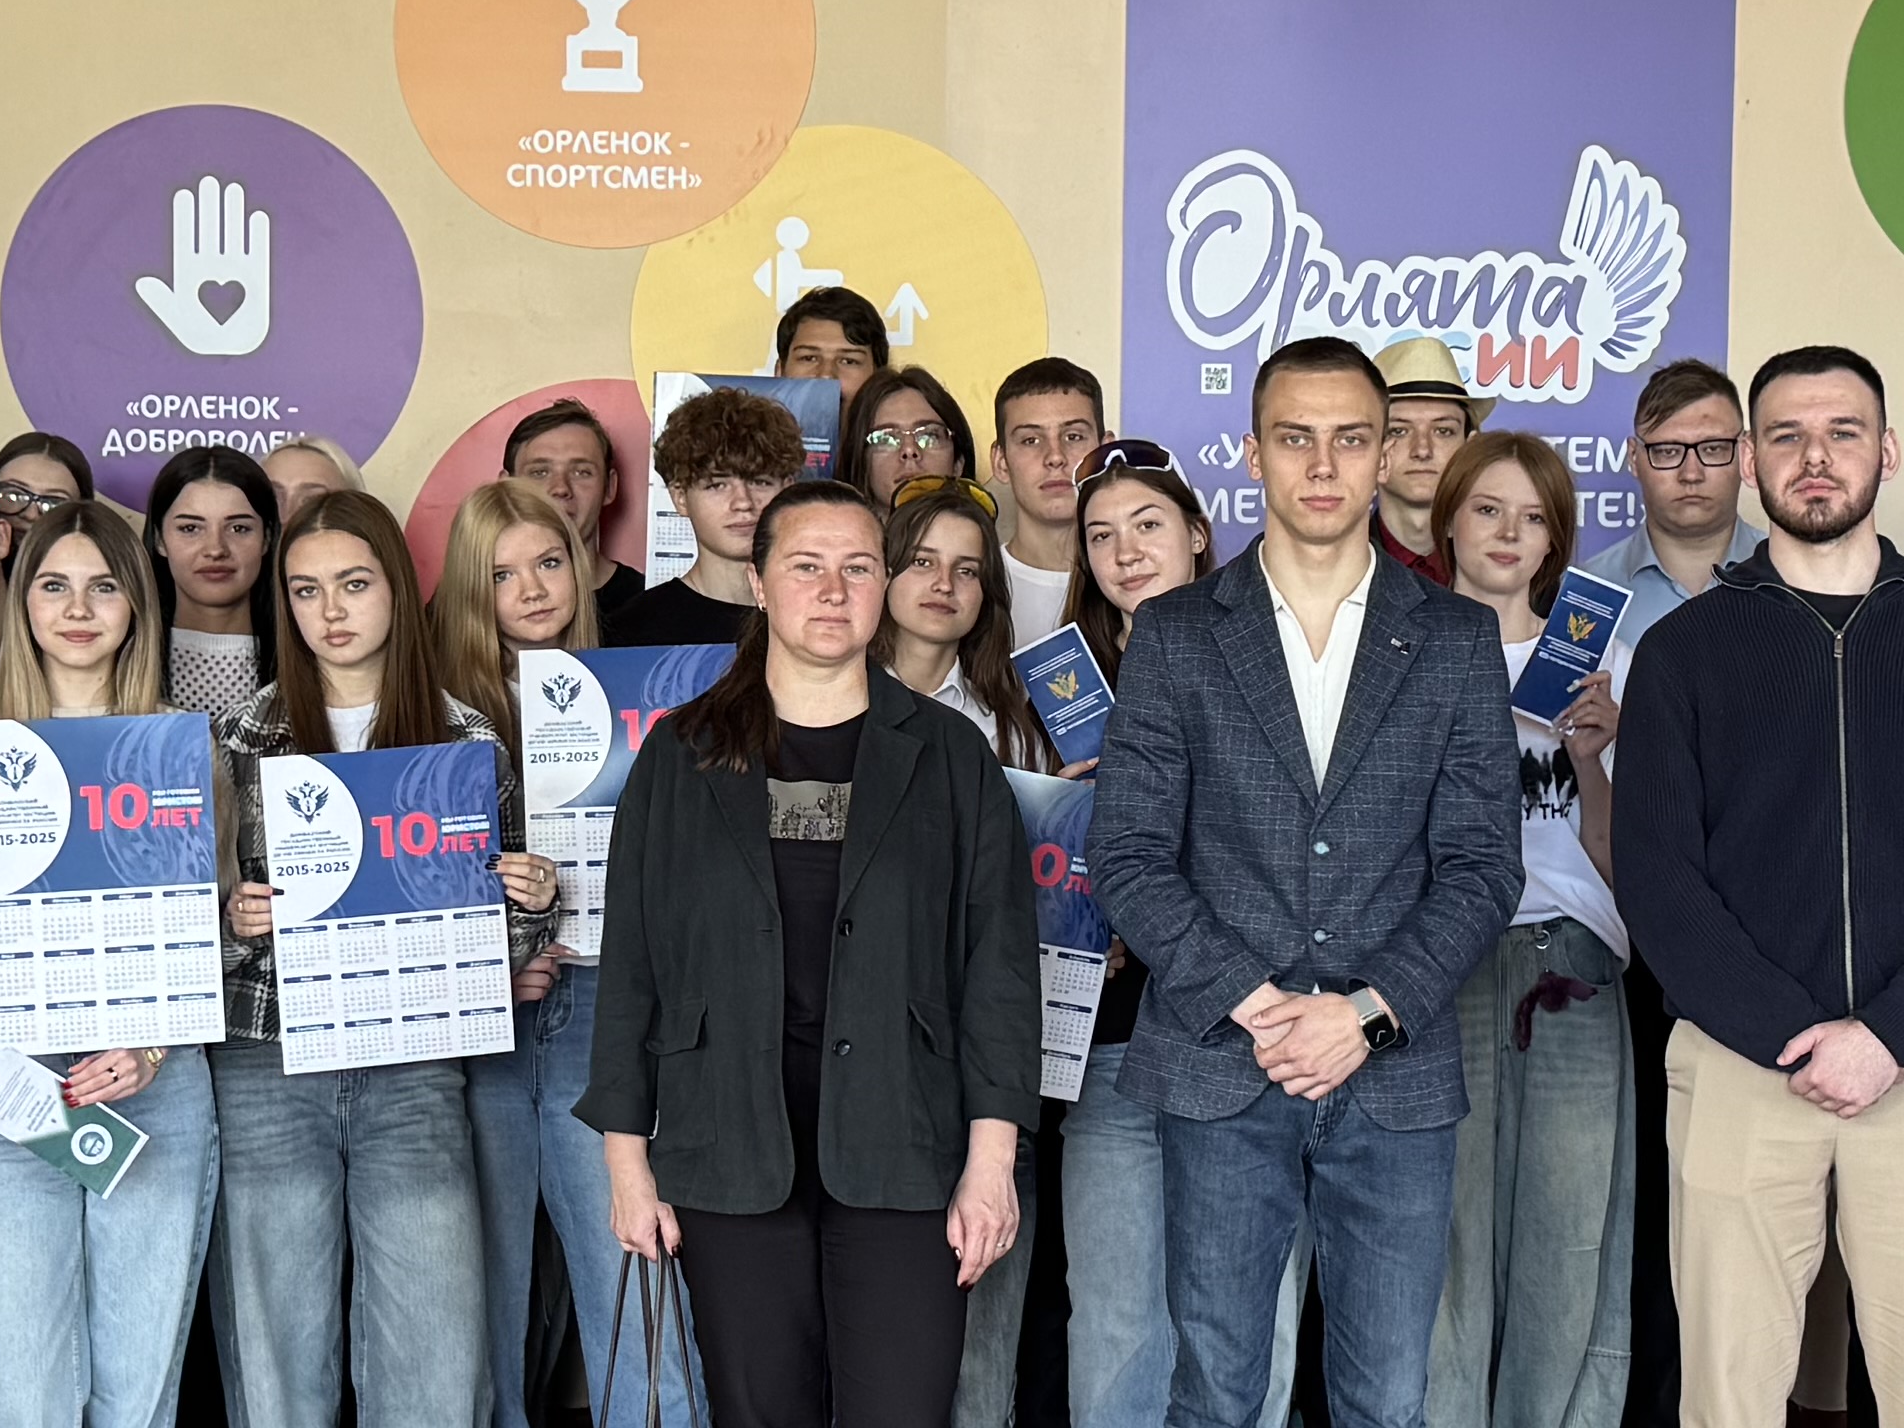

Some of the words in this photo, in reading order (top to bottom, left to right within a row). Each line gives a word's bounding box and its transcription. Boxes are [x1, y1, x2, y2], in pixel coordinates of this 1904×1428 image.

[518, 129, 672, 155] «ОРЛЕНОК
[506, 163, 702, 189] СПОРТСМЕН»
[1178, 160, 1586, 346] Орлята
[126, 394, 280, 420] «ОРЛЕНОК
[102, 428, 305, 457] ДОБРОВОЛЕ
[805, 453, 831, 467] ЕТ
[530, 751, 599, 764] 2015-2025
[80, 782, 150, 831] 10
[151, 807, 204, 829] ЛЕТ
[371, 811, 439, 859] 10
[440, 832, 491, 855] ЛЕТ
[276, 861, 351, 877] 2015-2025
